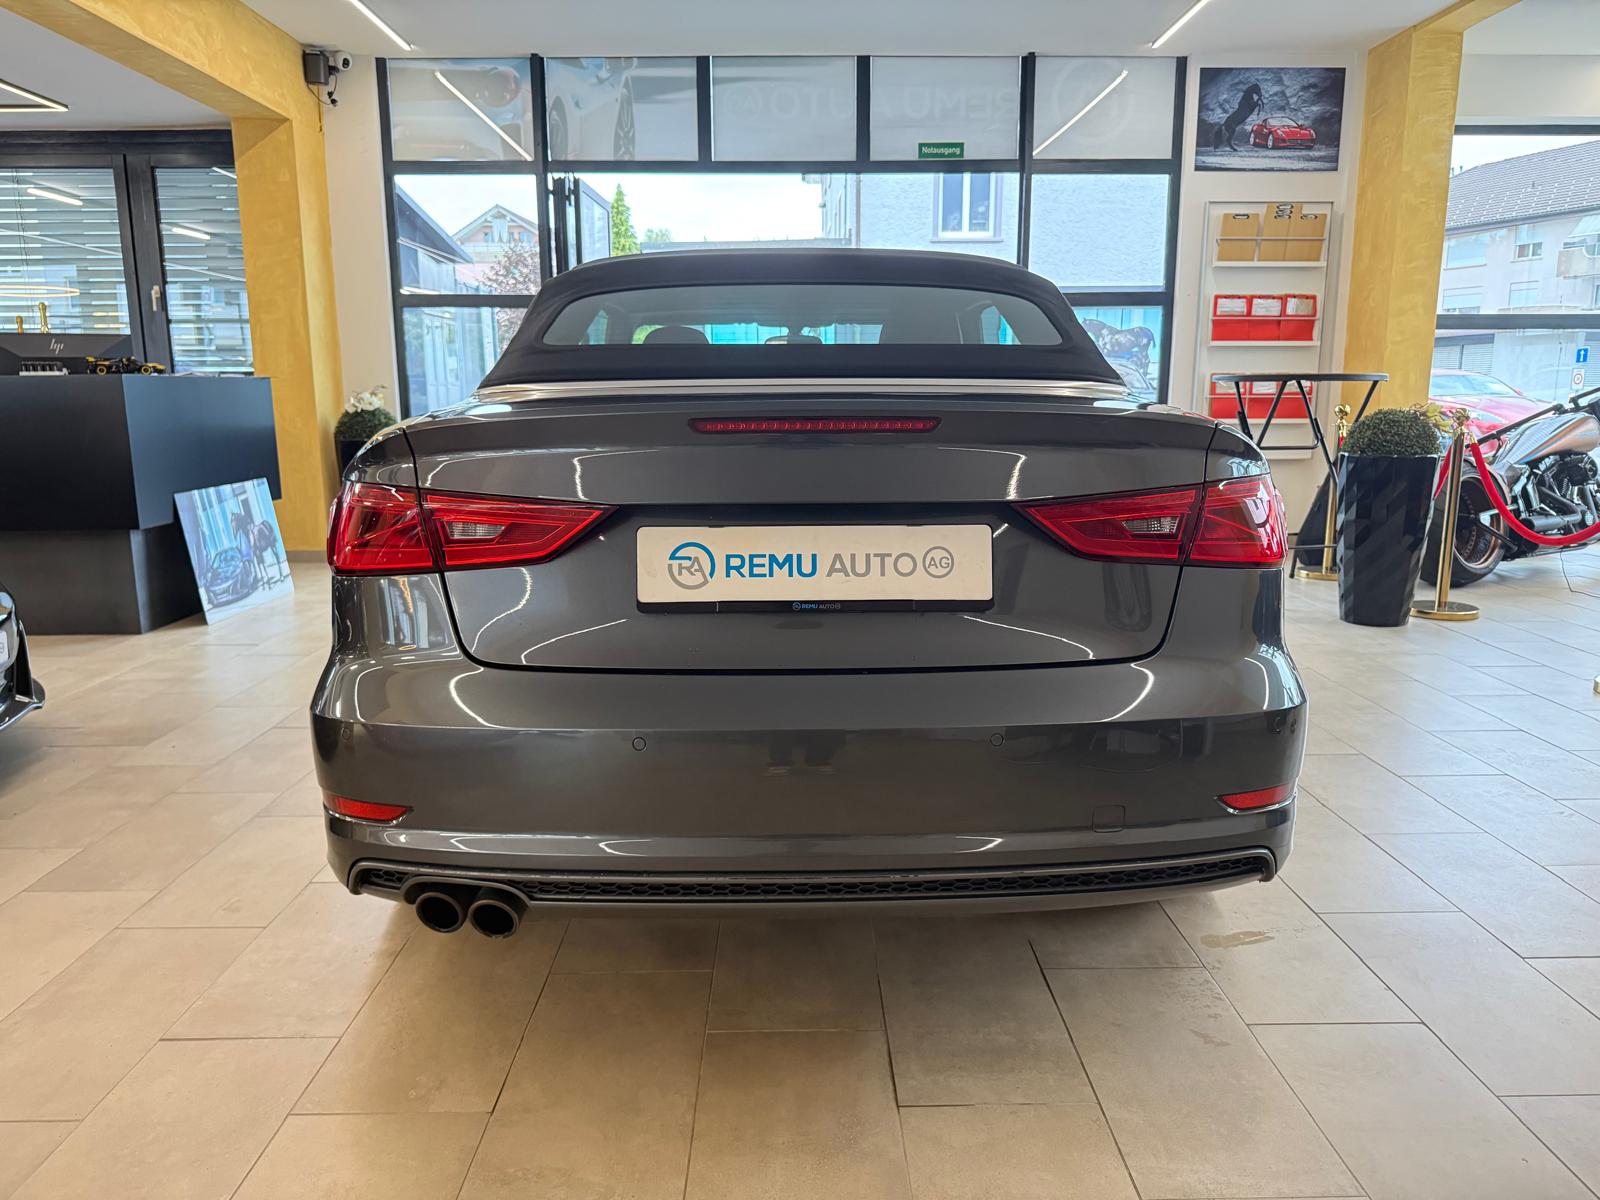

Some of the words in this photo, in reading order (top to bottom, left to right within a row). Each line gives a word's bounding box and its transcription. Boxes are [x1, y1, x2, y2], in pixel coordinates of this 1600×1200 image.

[921, 146, 961, 156] Notausgang
[50, 338, 64, 355] hp
[725, 553, 818, 578] REMU
[826, 552, 918, 578] AUTO
